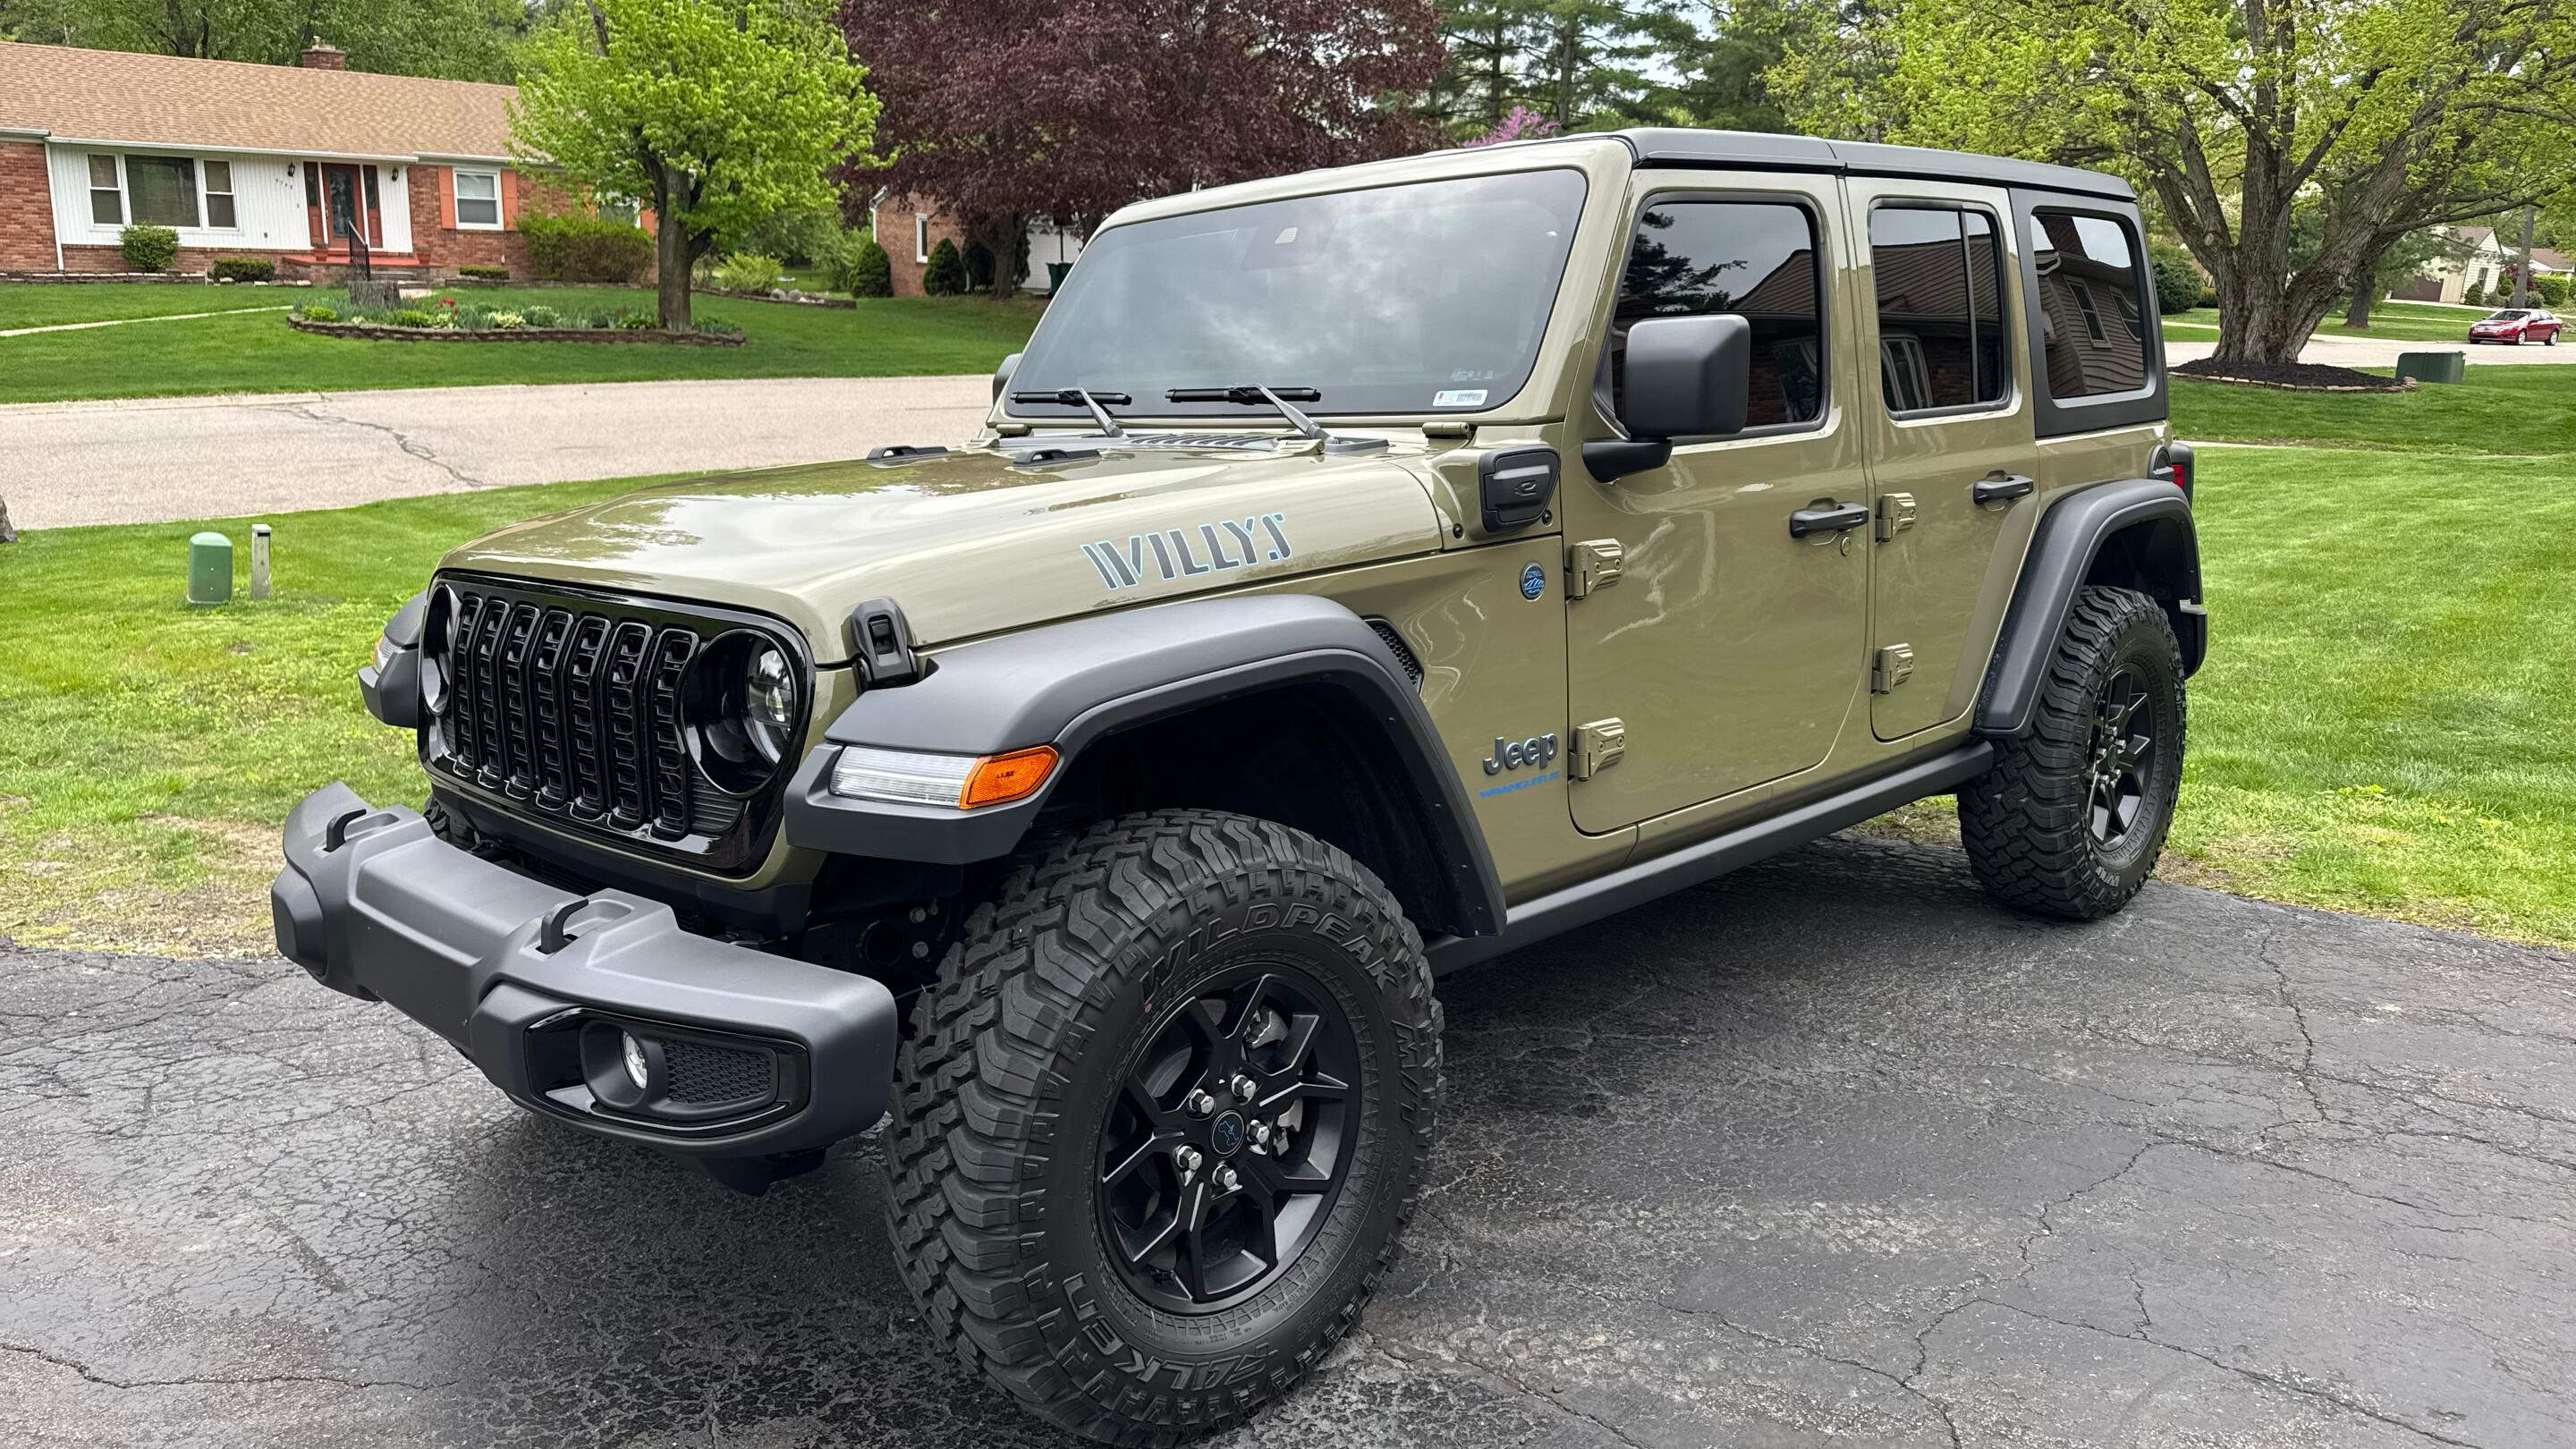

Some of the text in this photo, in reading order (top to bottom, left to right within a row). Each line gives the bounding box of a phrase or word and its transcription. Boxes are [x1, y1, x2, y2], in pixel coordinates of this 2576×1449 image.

[1080, 512, 1292, 590] WILLYS
[1483, 733, 1558, 775] Jeep
[1140, 902, 1401, 1004] WILDPEAK
[1063, 1272, 1280, 1391] FALKEN
